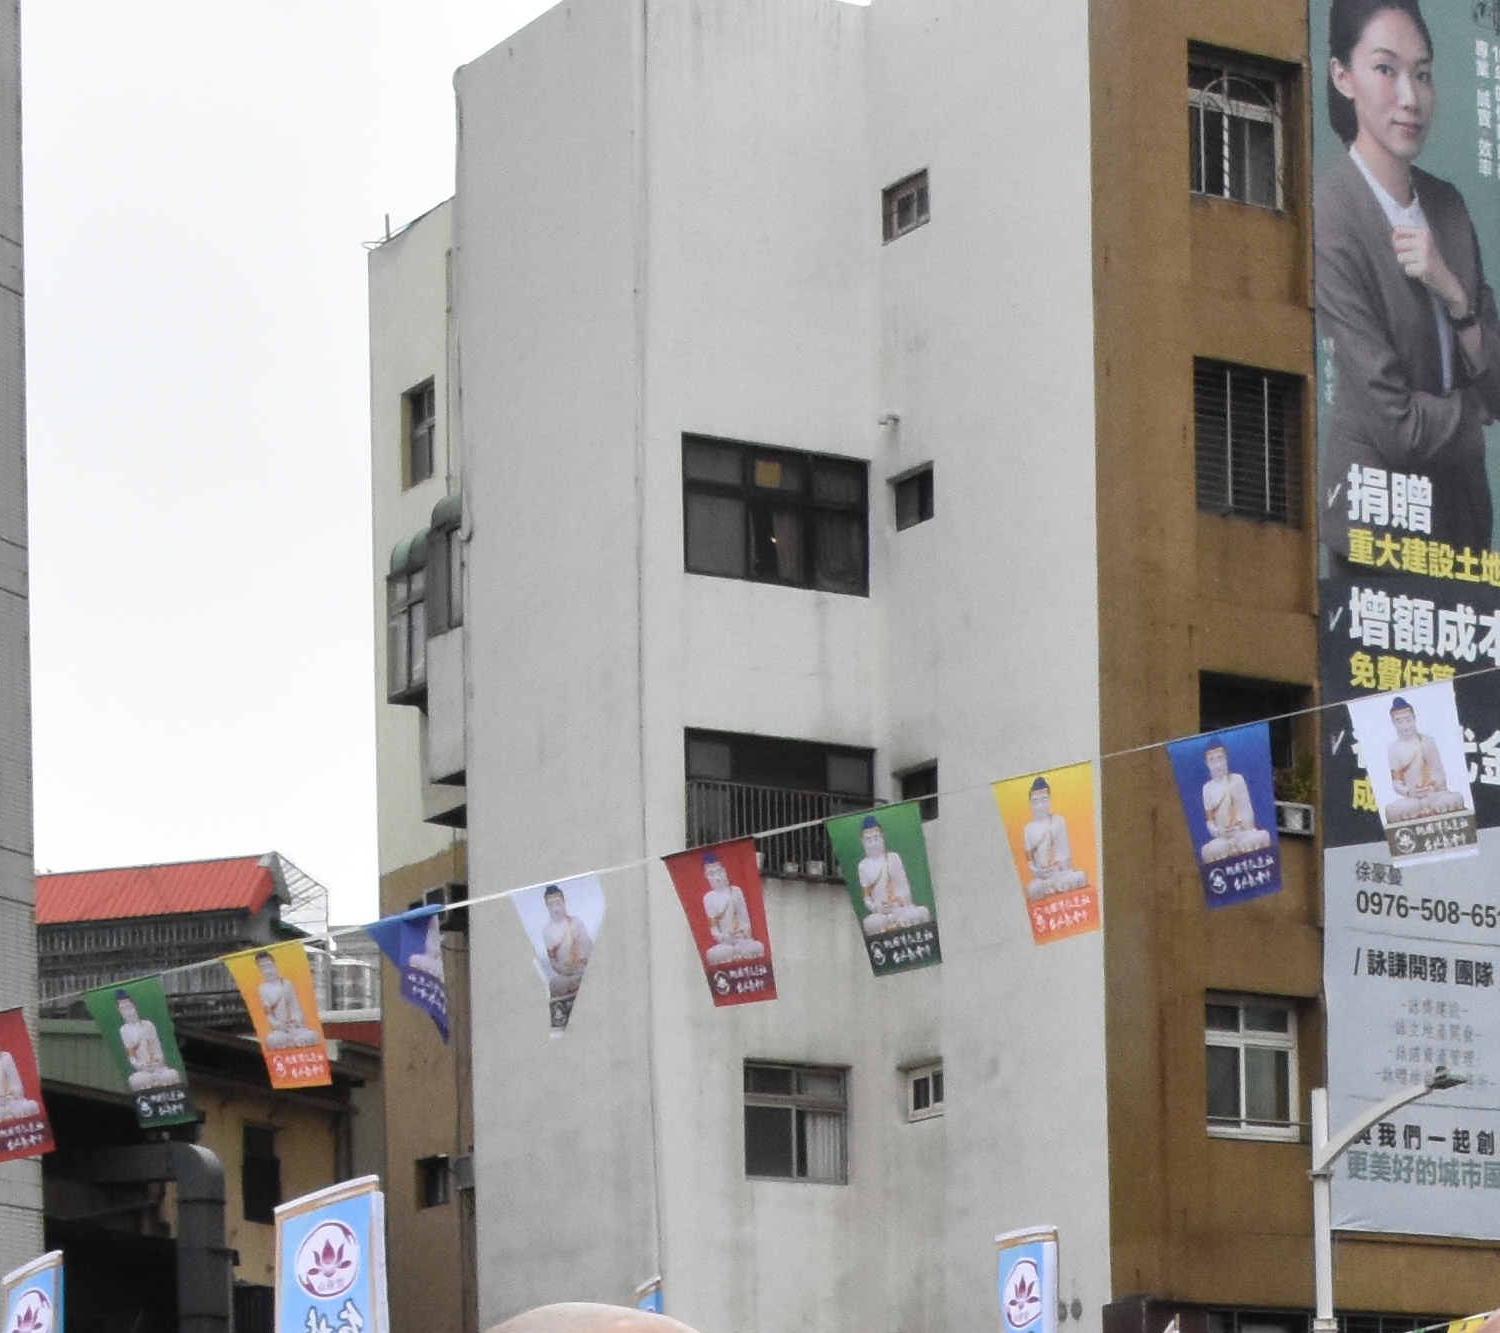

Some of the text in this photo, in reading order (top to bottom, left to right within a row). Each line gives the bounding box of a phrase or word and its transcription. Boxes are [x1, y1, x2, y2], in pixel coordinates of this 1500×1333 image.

[1347, 463, 1433, 534] 捐贈
[1367, 949, 1495, 989] 詠謙開發 團隊
